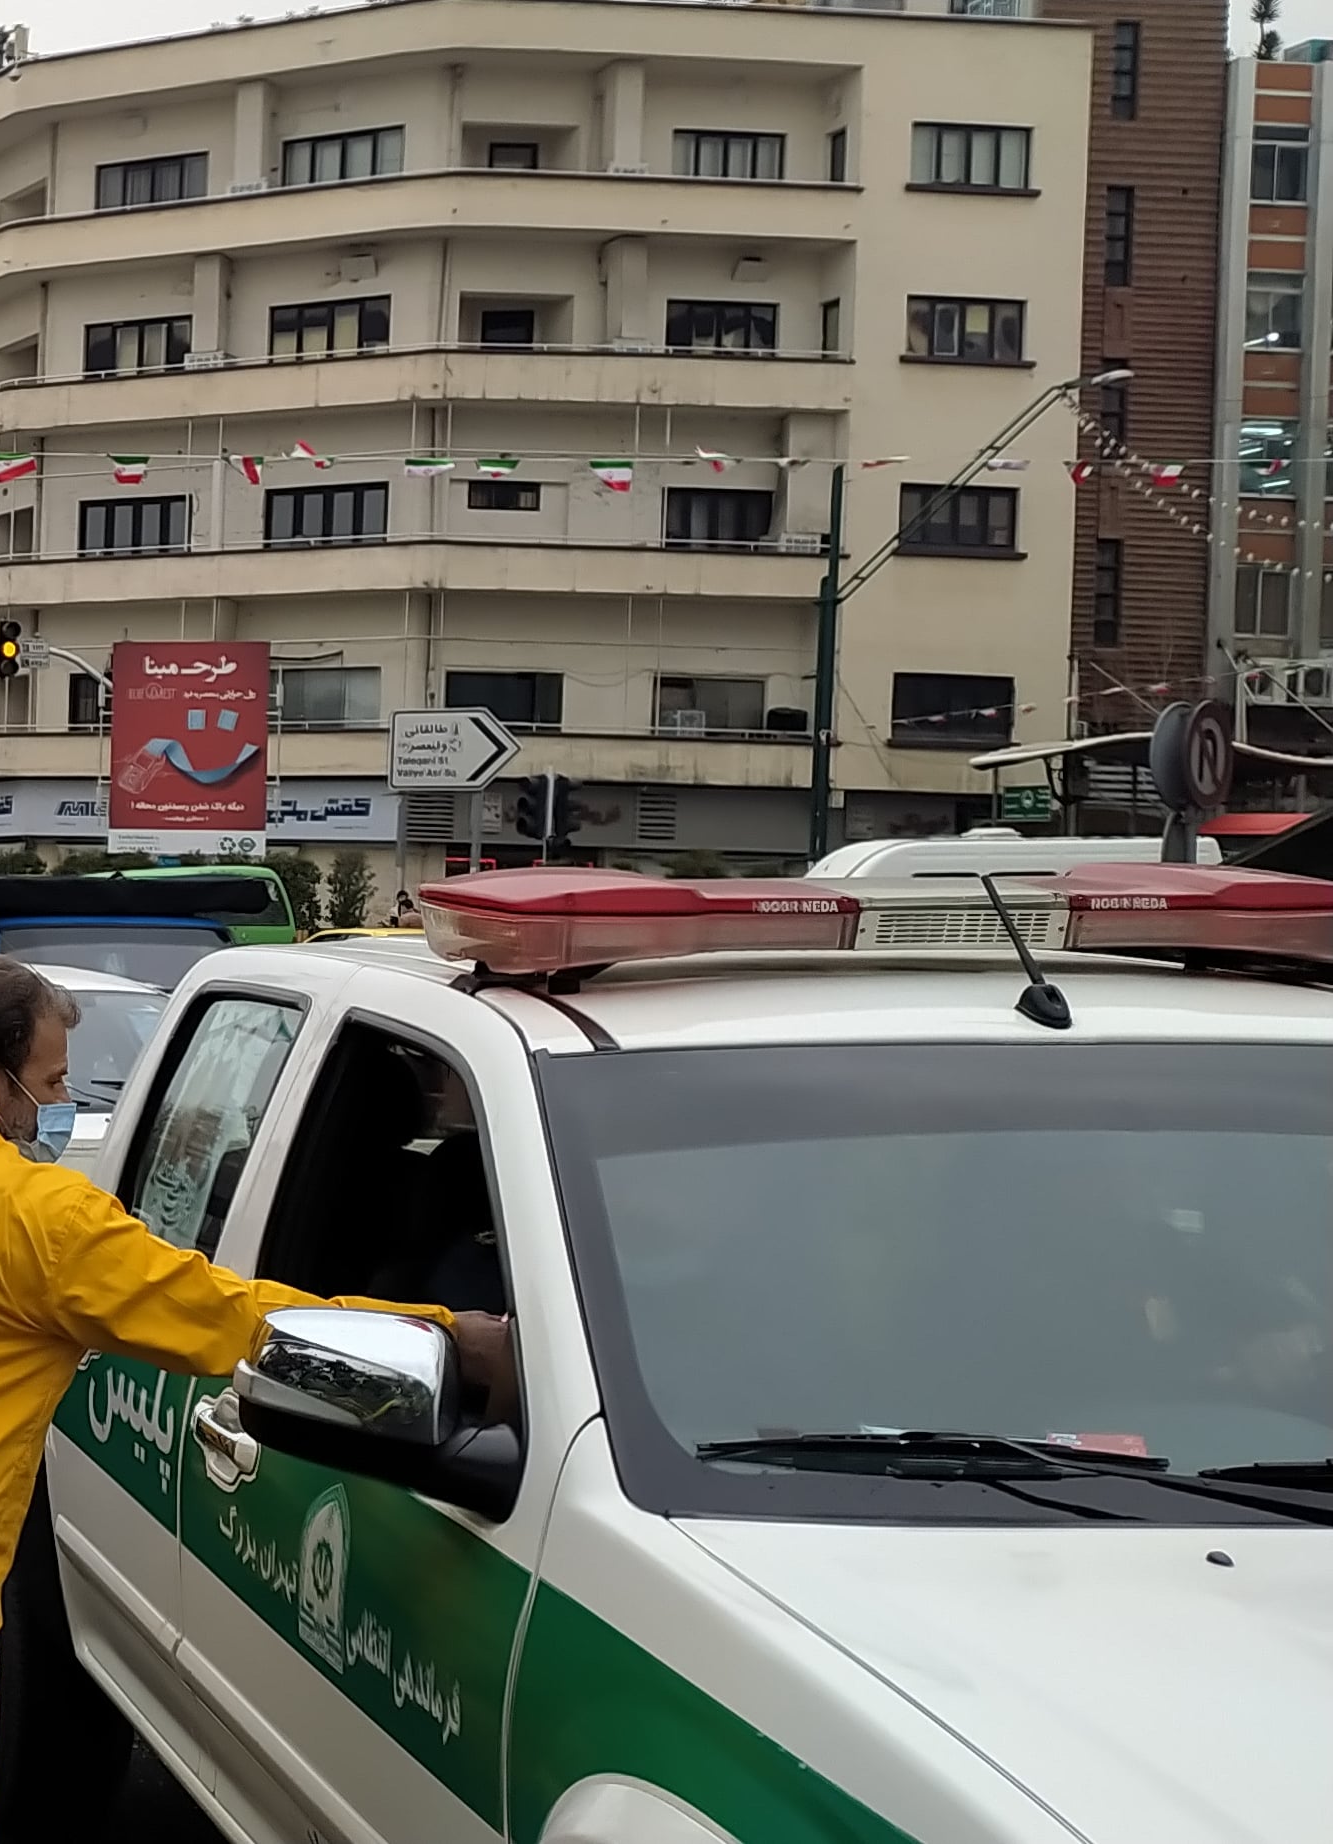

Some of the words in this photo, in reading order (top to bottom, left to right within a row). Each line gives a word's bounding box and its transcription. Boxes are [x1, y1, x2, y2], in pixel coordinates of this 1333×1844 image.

[404, 723, 449, 739] طالقانی
[407, 740, 448, 754] ولیعصر
[801, 900, 839, 913] NEDA
[88, 1365, 175, 1495] پلیس
[219, 1505, 258, 1573] بزرگ
[259, 1538, 300, 1604] تهران
[346, 1608, 392, 1678] انتظامی
[394, 1652, 461, 1745] فرماندهی
